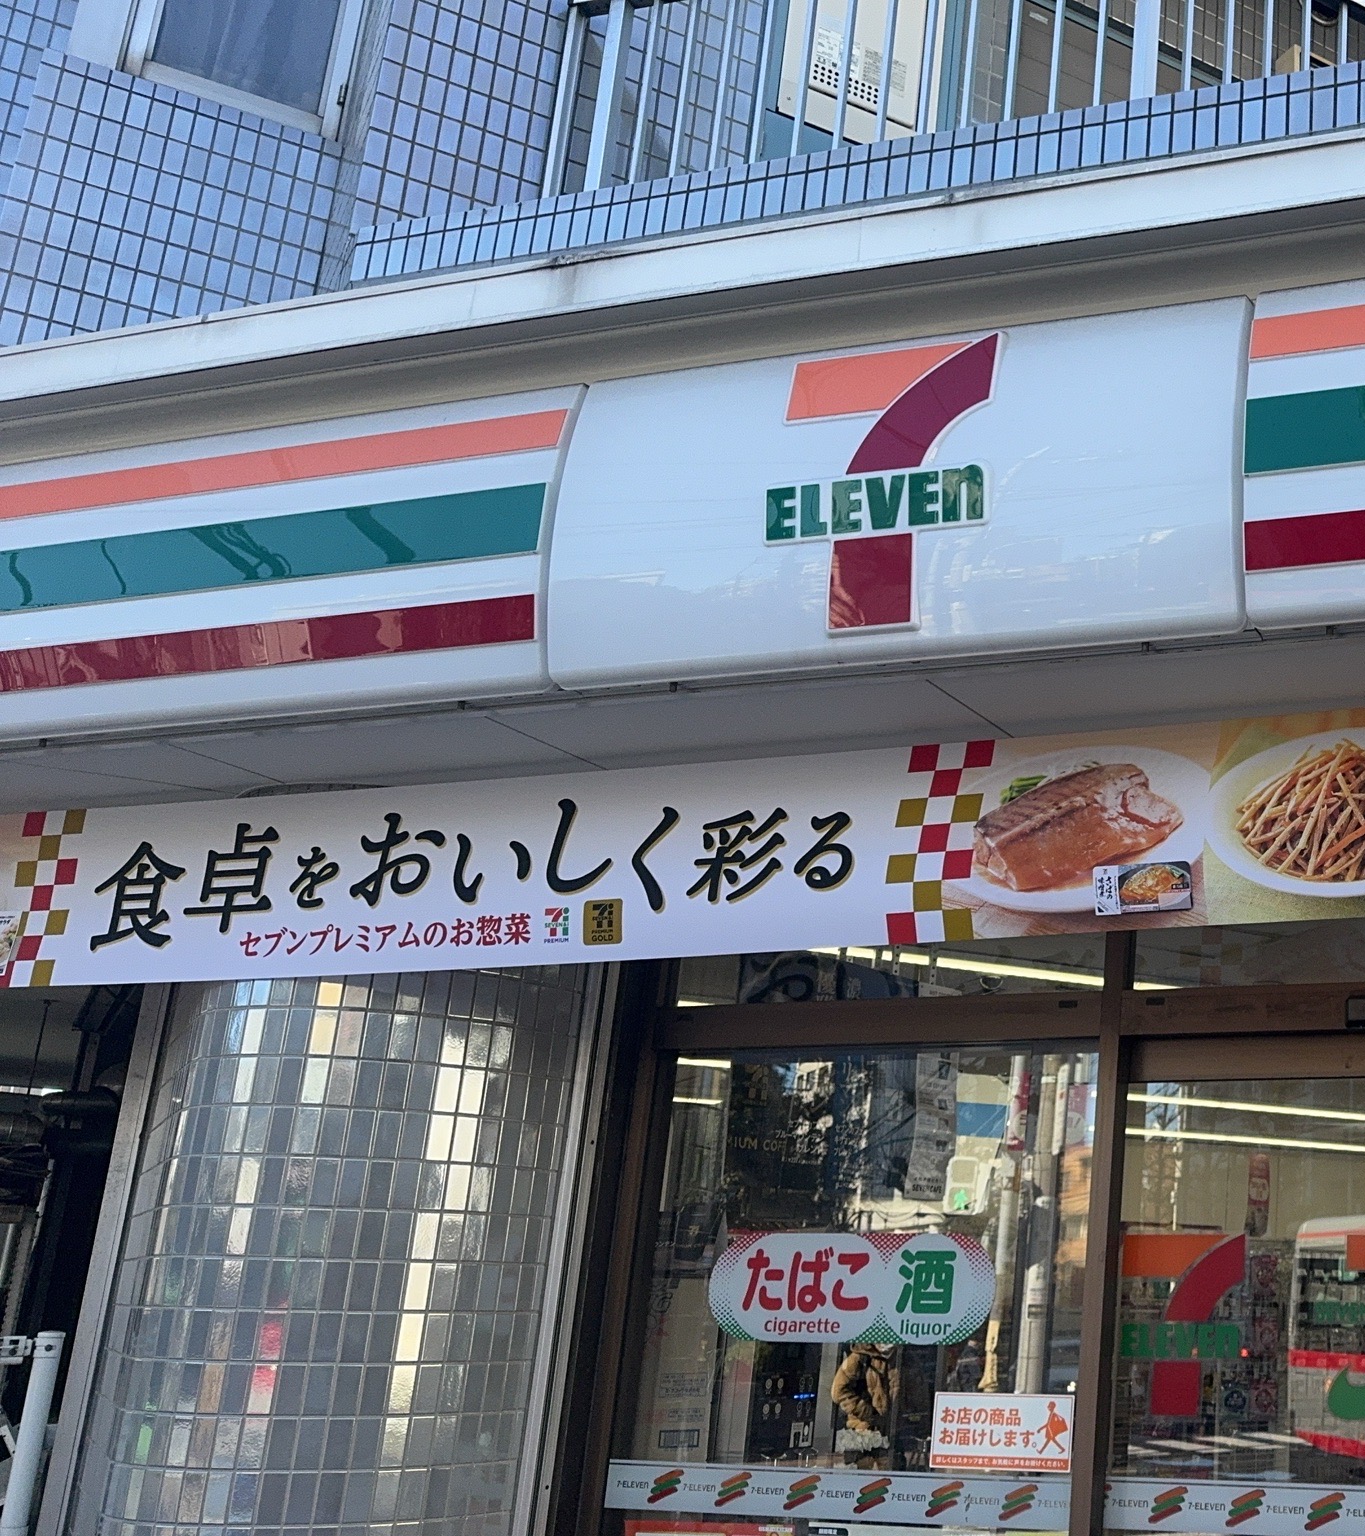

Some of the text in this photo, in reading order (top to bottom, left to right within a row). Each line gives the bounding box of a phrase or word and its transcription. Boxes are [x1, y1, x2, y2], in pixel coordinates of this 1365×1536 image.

[89, 798, 854, 953] 食卓をおいしく彩る
[240, 912, 531, 959] セブンプレミアムのお惣菜
[592, 934, 613, 942] GOLD
[742, 1246, 870, 1313] たばこ
[896, 1249, 957, 1314] 酒
[764, 1317, 952, 1338] cigarette liquor
[940, 1406, 1021, 1427] お店の商品
[938, 1428, 1037, 1448] お届けします。
